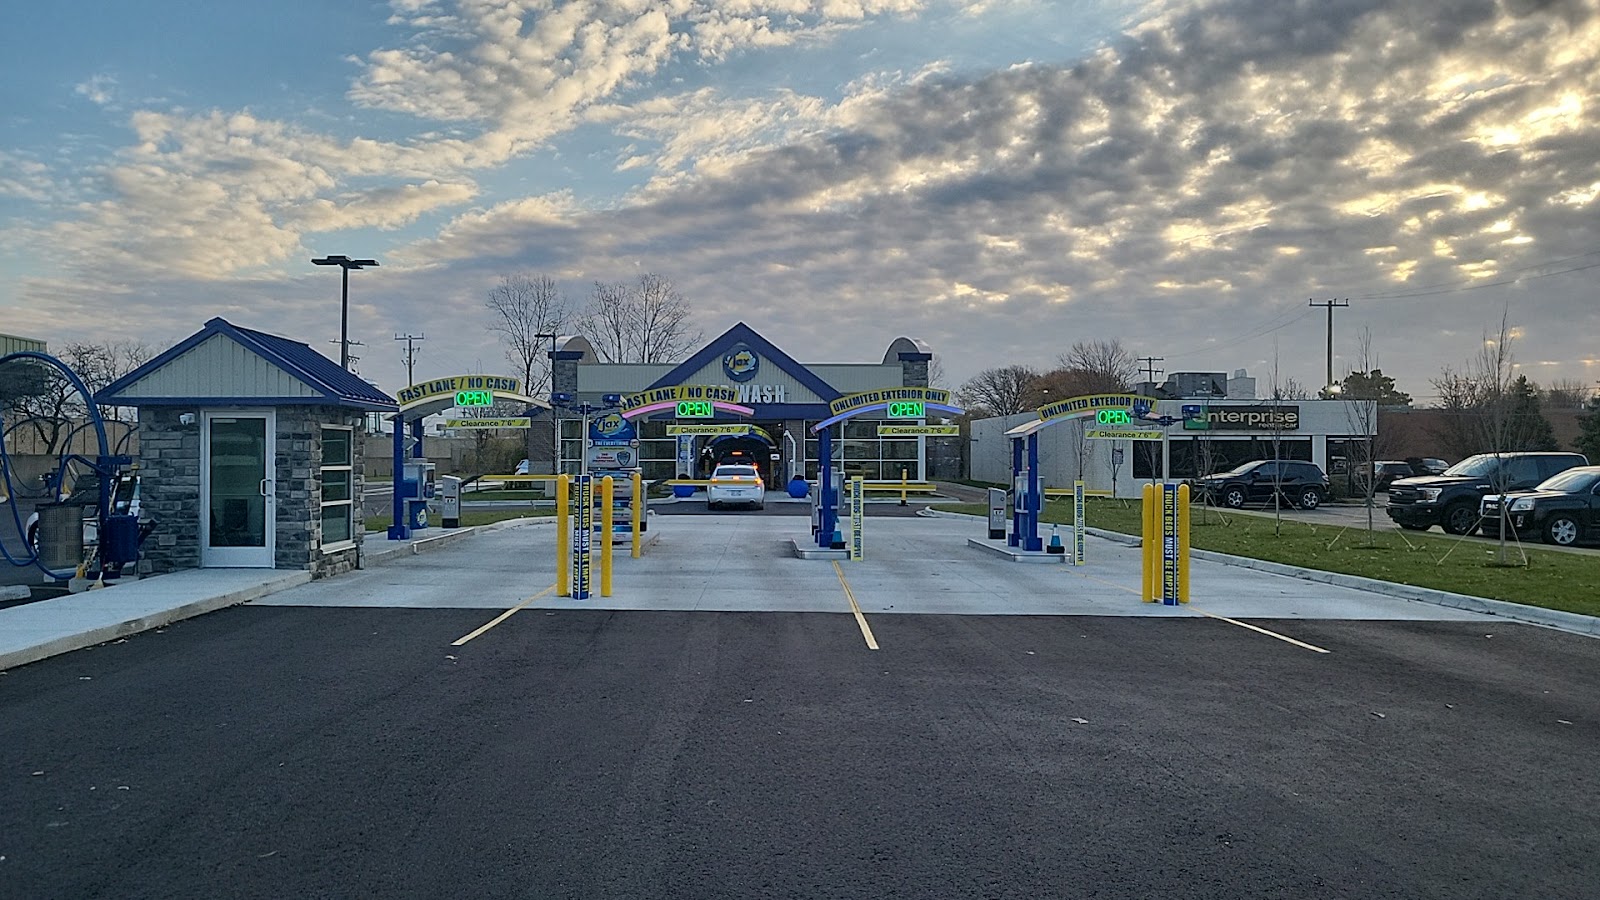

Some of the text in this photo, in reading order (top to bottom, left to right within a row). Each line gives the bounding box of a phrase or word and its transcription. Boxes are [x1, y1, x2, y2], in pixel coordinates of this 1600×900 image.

[400, 377, 516, 402] FAST LANE / NO CASH
[650, 388, 676, 402] LANE
[680, 387, 684, 398] /
[688, 387, 702, 398] NO
[706, 387, 736, 401] CASH
[735, 384, 785, 404] WASH
[456, 391, 491, 406] OPEN
[833, 389, 947, 412] UNLIMITED EXTERIOR ONLY
[678, 402, 711, 416] OPEN
[889, 402, 922, 417] OPEN
[1041, 399, 1088, 419] UNLIMITED
[1090, 396, 1131, 407] EXTERIOR
[599, 417, 620, 433] jax
[1098, 410, 1131, 424] OPEN
[1191, 410, 1298, 426] enterprise
[581, 529, 590, 551] MUST
[1165, 490, 1174, 599] TRUCK BEDS MUST BE EMPTY!
[581, 552, 589, 562] BE
